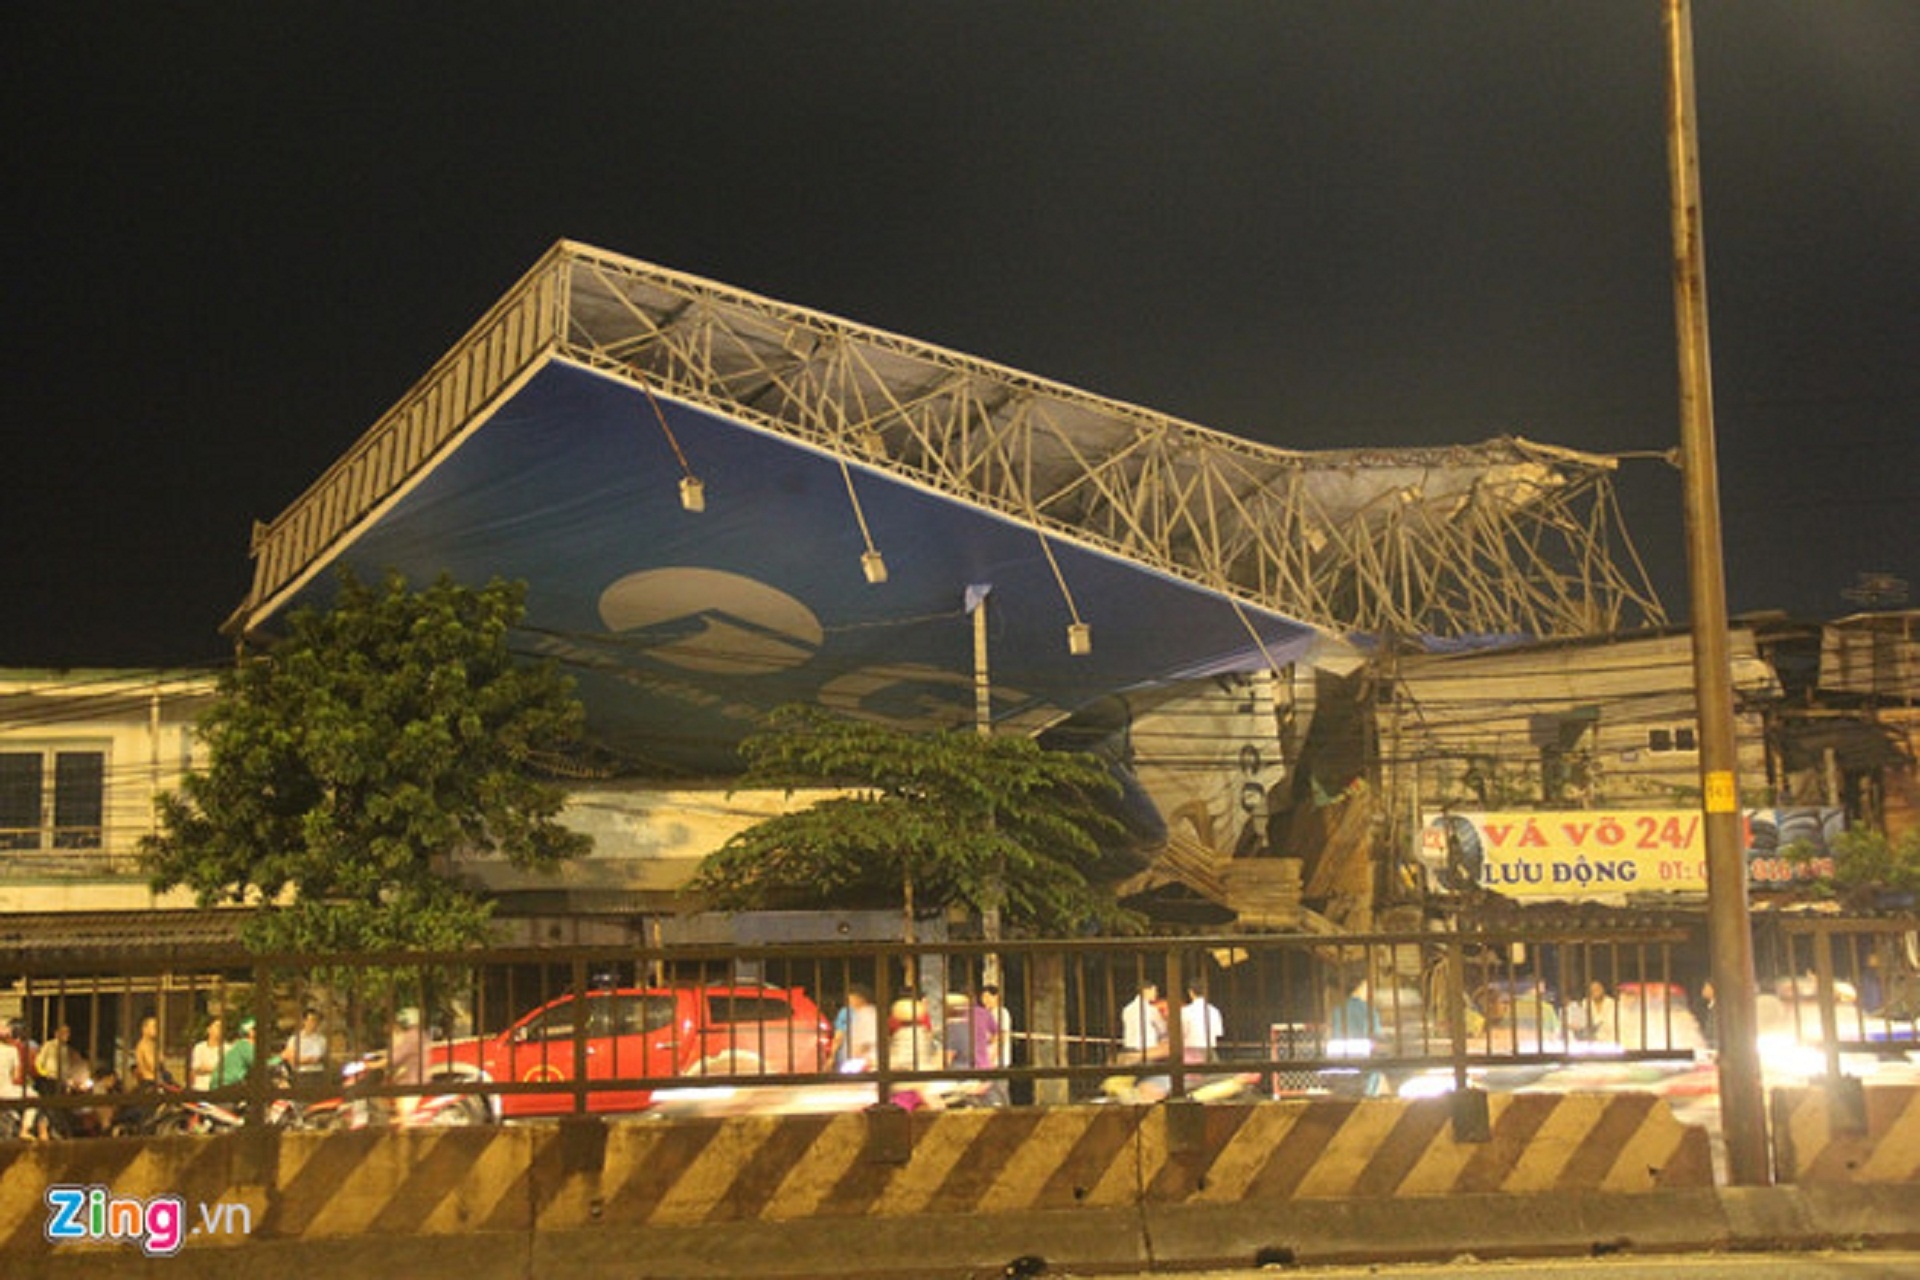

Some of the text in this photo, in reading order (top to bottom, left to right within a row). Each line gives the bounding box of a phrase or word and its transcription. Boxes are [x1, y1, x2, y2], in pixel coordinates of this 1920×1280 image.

[1483, 817, 1548, 848] VÁ
[1484, 857, 1543, 884] LƯU
[1552, 854, 1637, 888] ĐỘNG
